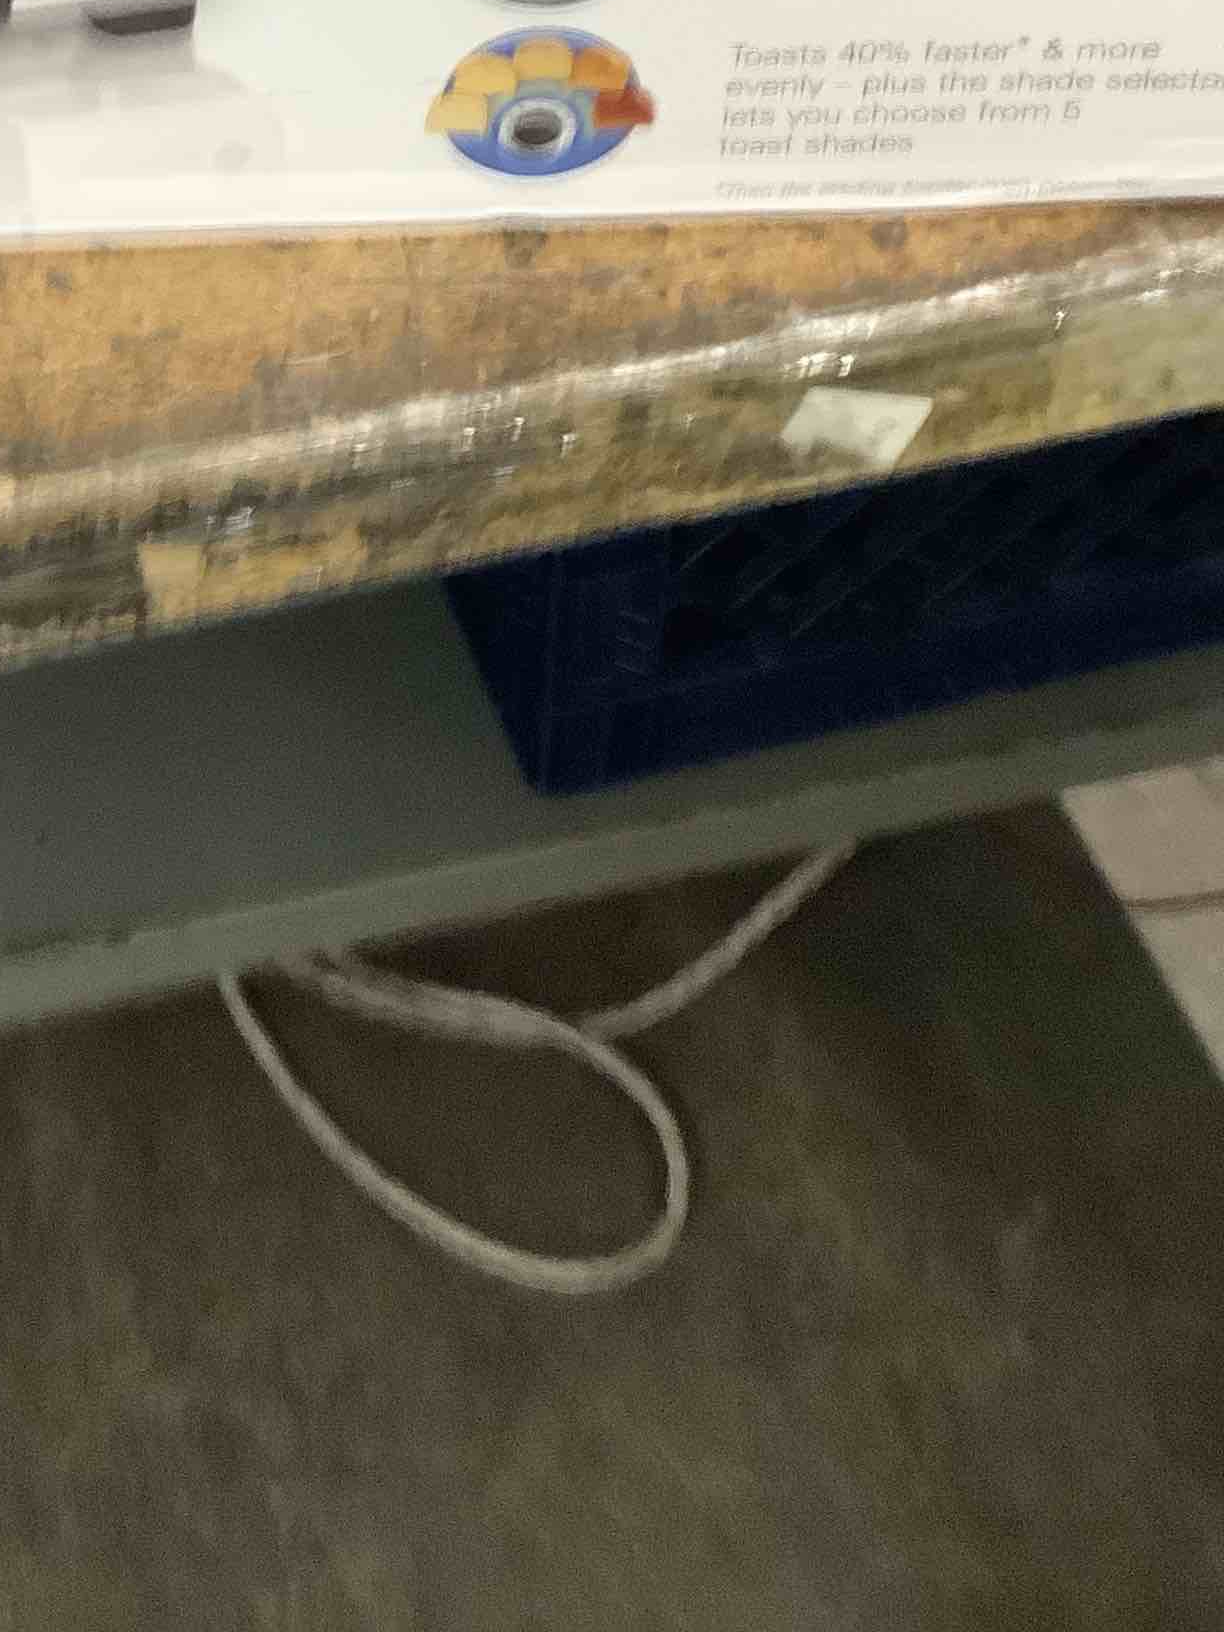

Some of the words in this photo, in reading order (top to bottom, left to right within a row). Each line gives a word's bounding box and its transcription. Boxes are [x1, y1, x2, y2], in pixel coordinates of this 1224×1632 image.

[728, 42, 826, 68] Toasts
[838, 40, 911, 65] 40%
[1041, 37, 1065, 61] &
[1077, 40, 1163, 63] more
[725, 73, 824, 100] evenly
[861, 72, 927, 99] plus
[939, 71, 988, 95] the
[999, 69, 1095, 93] shade
[722, 106, 776, 129] lets
[786, 107, 841, 130] you
[852, 103, 967, 126] choose
[978, 100, 1051, 123] from
[720, 134, 793, 157] toast
[805, 134, 913, 156] shades
